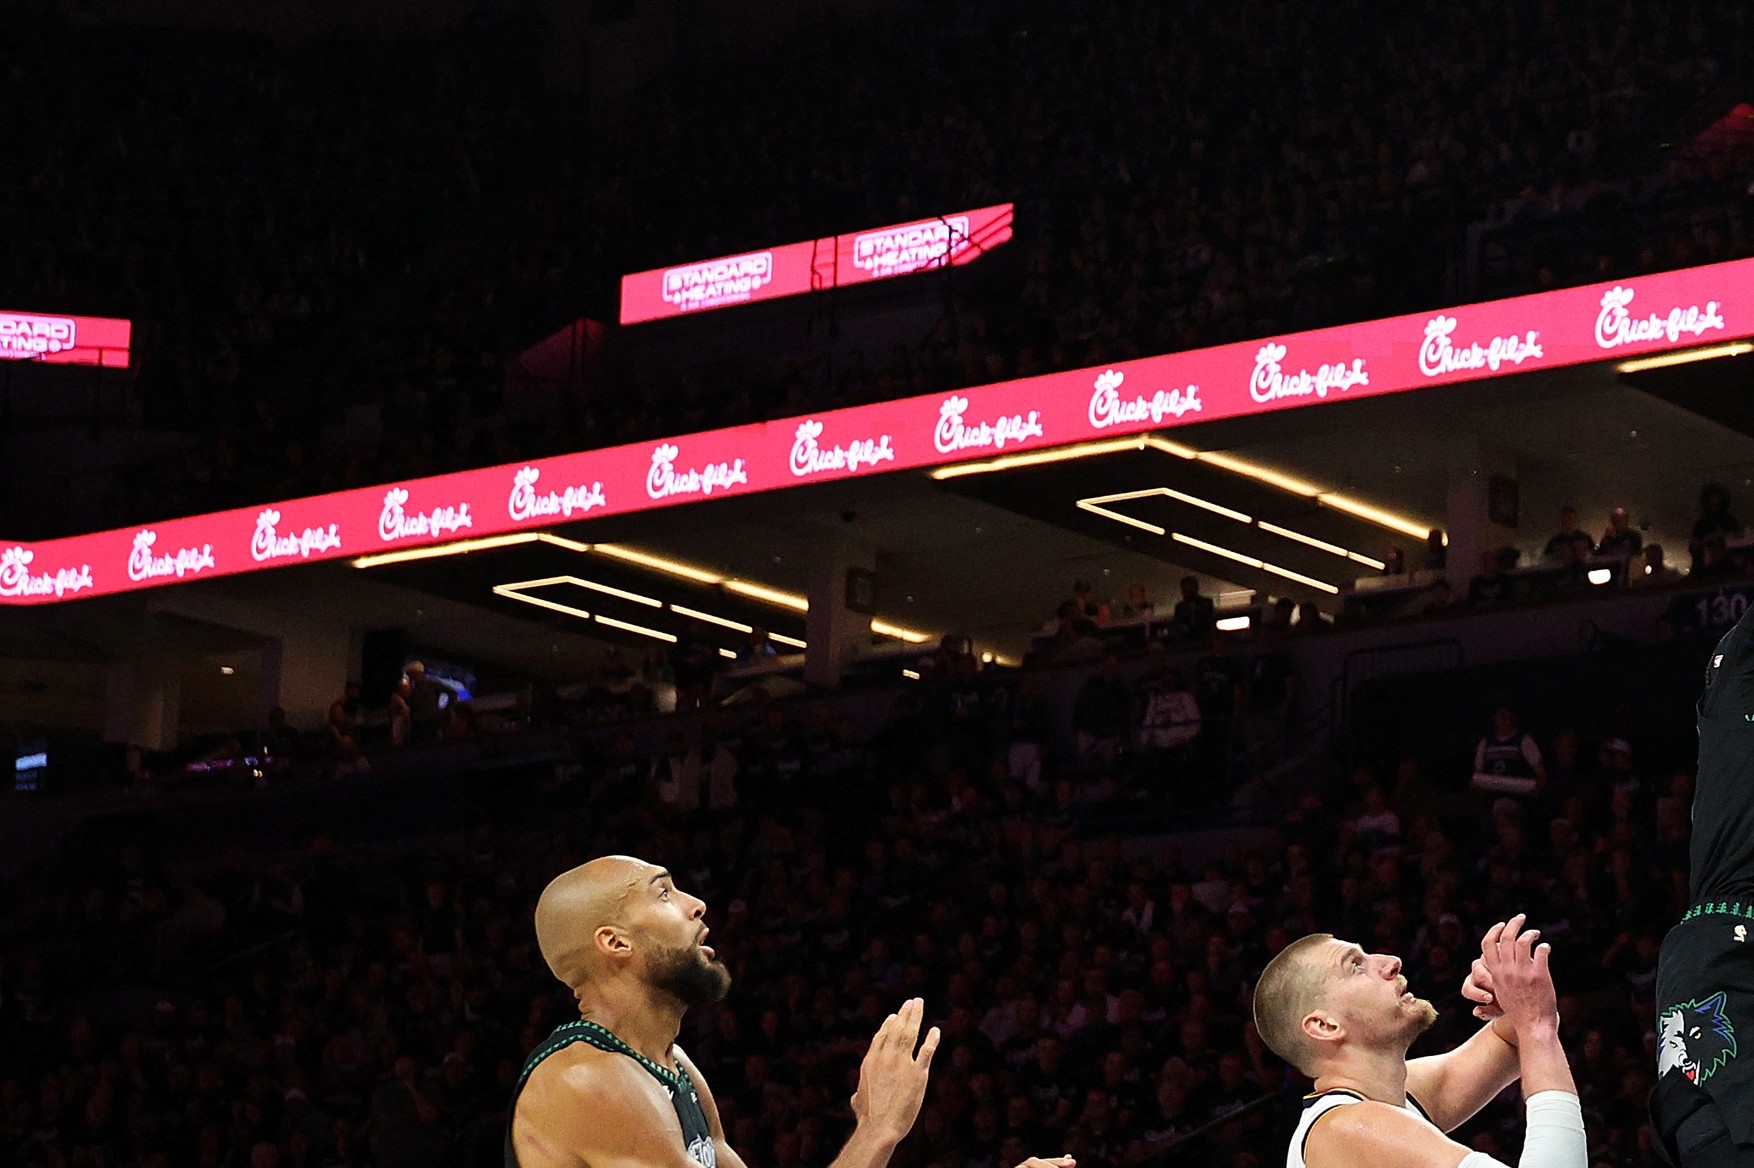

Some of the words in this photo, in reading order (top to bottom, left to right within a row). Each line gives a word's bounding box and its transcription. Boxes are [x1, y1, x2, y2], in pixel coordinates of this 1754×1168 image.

[668, 257, 768, 291] STANDARD
[681, 276, 752, 302] HEATING
[0, 320, 69, 341] DARD
[0, 335, 49, 353] TING
